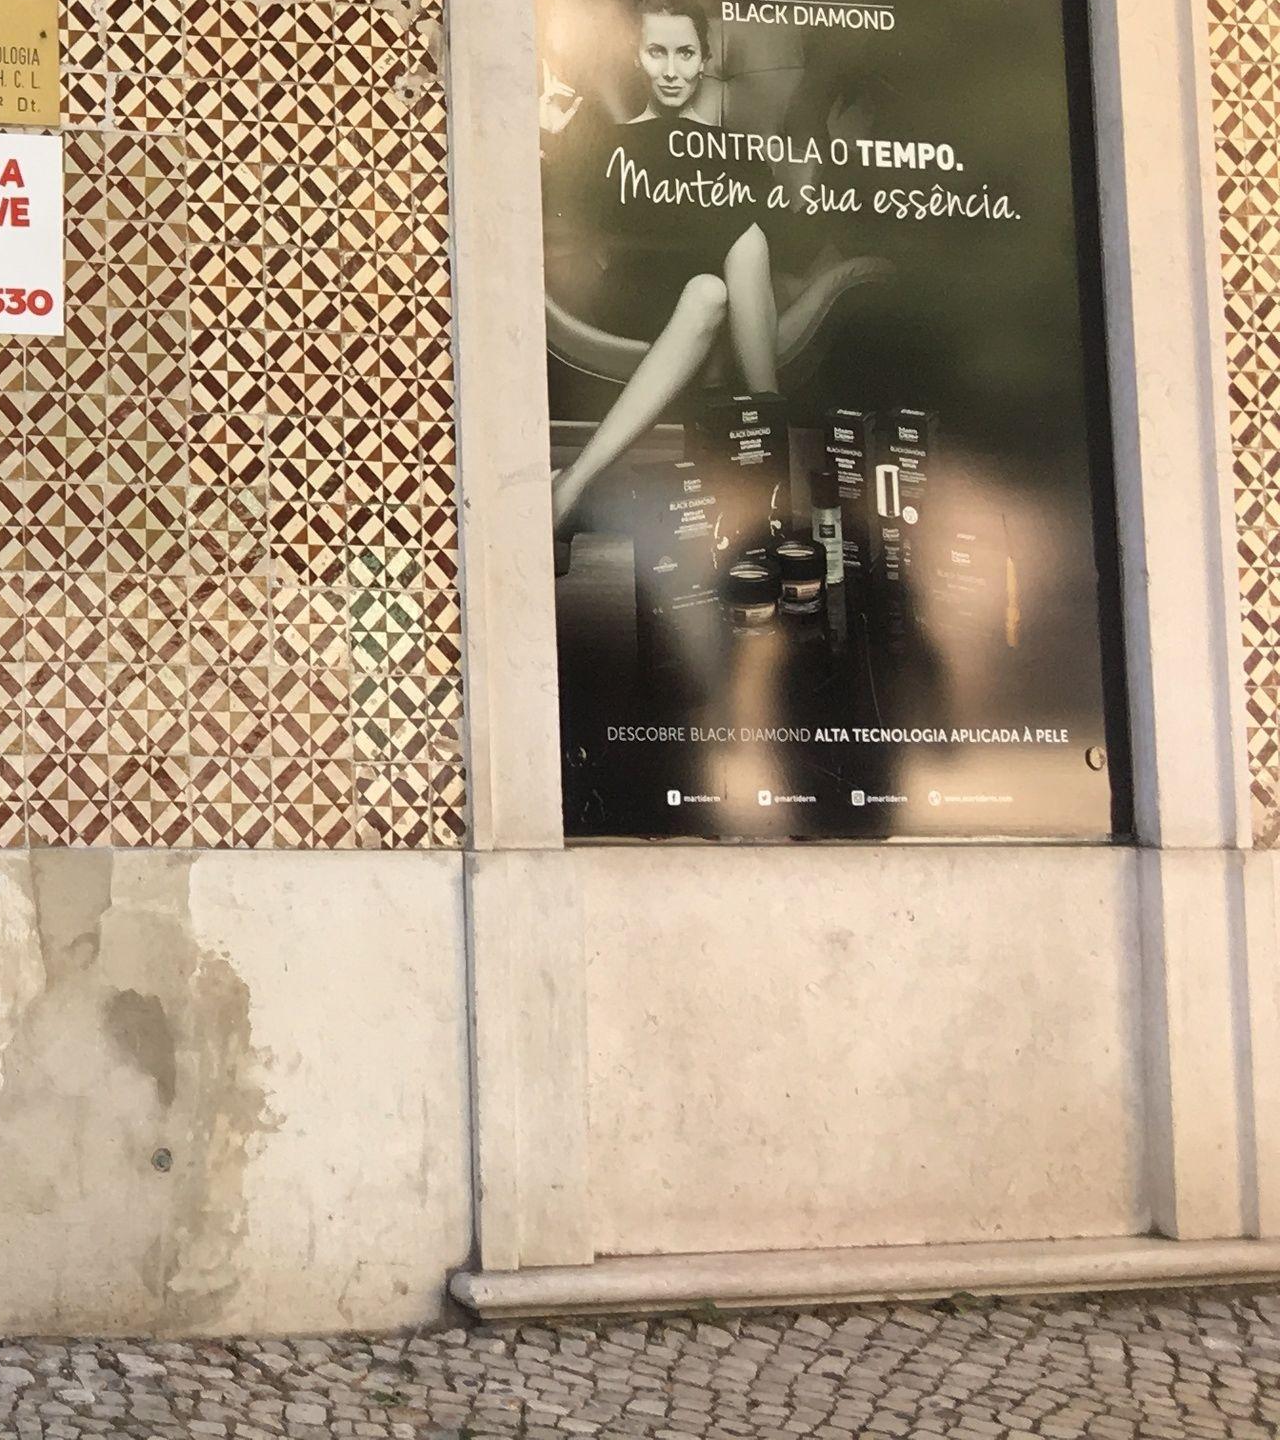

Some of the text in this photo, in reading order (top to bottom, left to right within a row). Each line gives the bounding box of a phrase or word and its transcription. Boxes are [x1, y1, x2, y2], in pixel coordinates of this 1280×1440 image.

[721, 1, 896, 31] BLACK DIAMOND
[668, 129, 964, 172] CONTROLA O TEMPO.
[606, 146, 1022, 221] Mantém a sua essência.
[607, 725, 1069, 743] DESCOBRE BLACK DIAMOND ALTA TECNOLOGIA APLICADA À PELE
